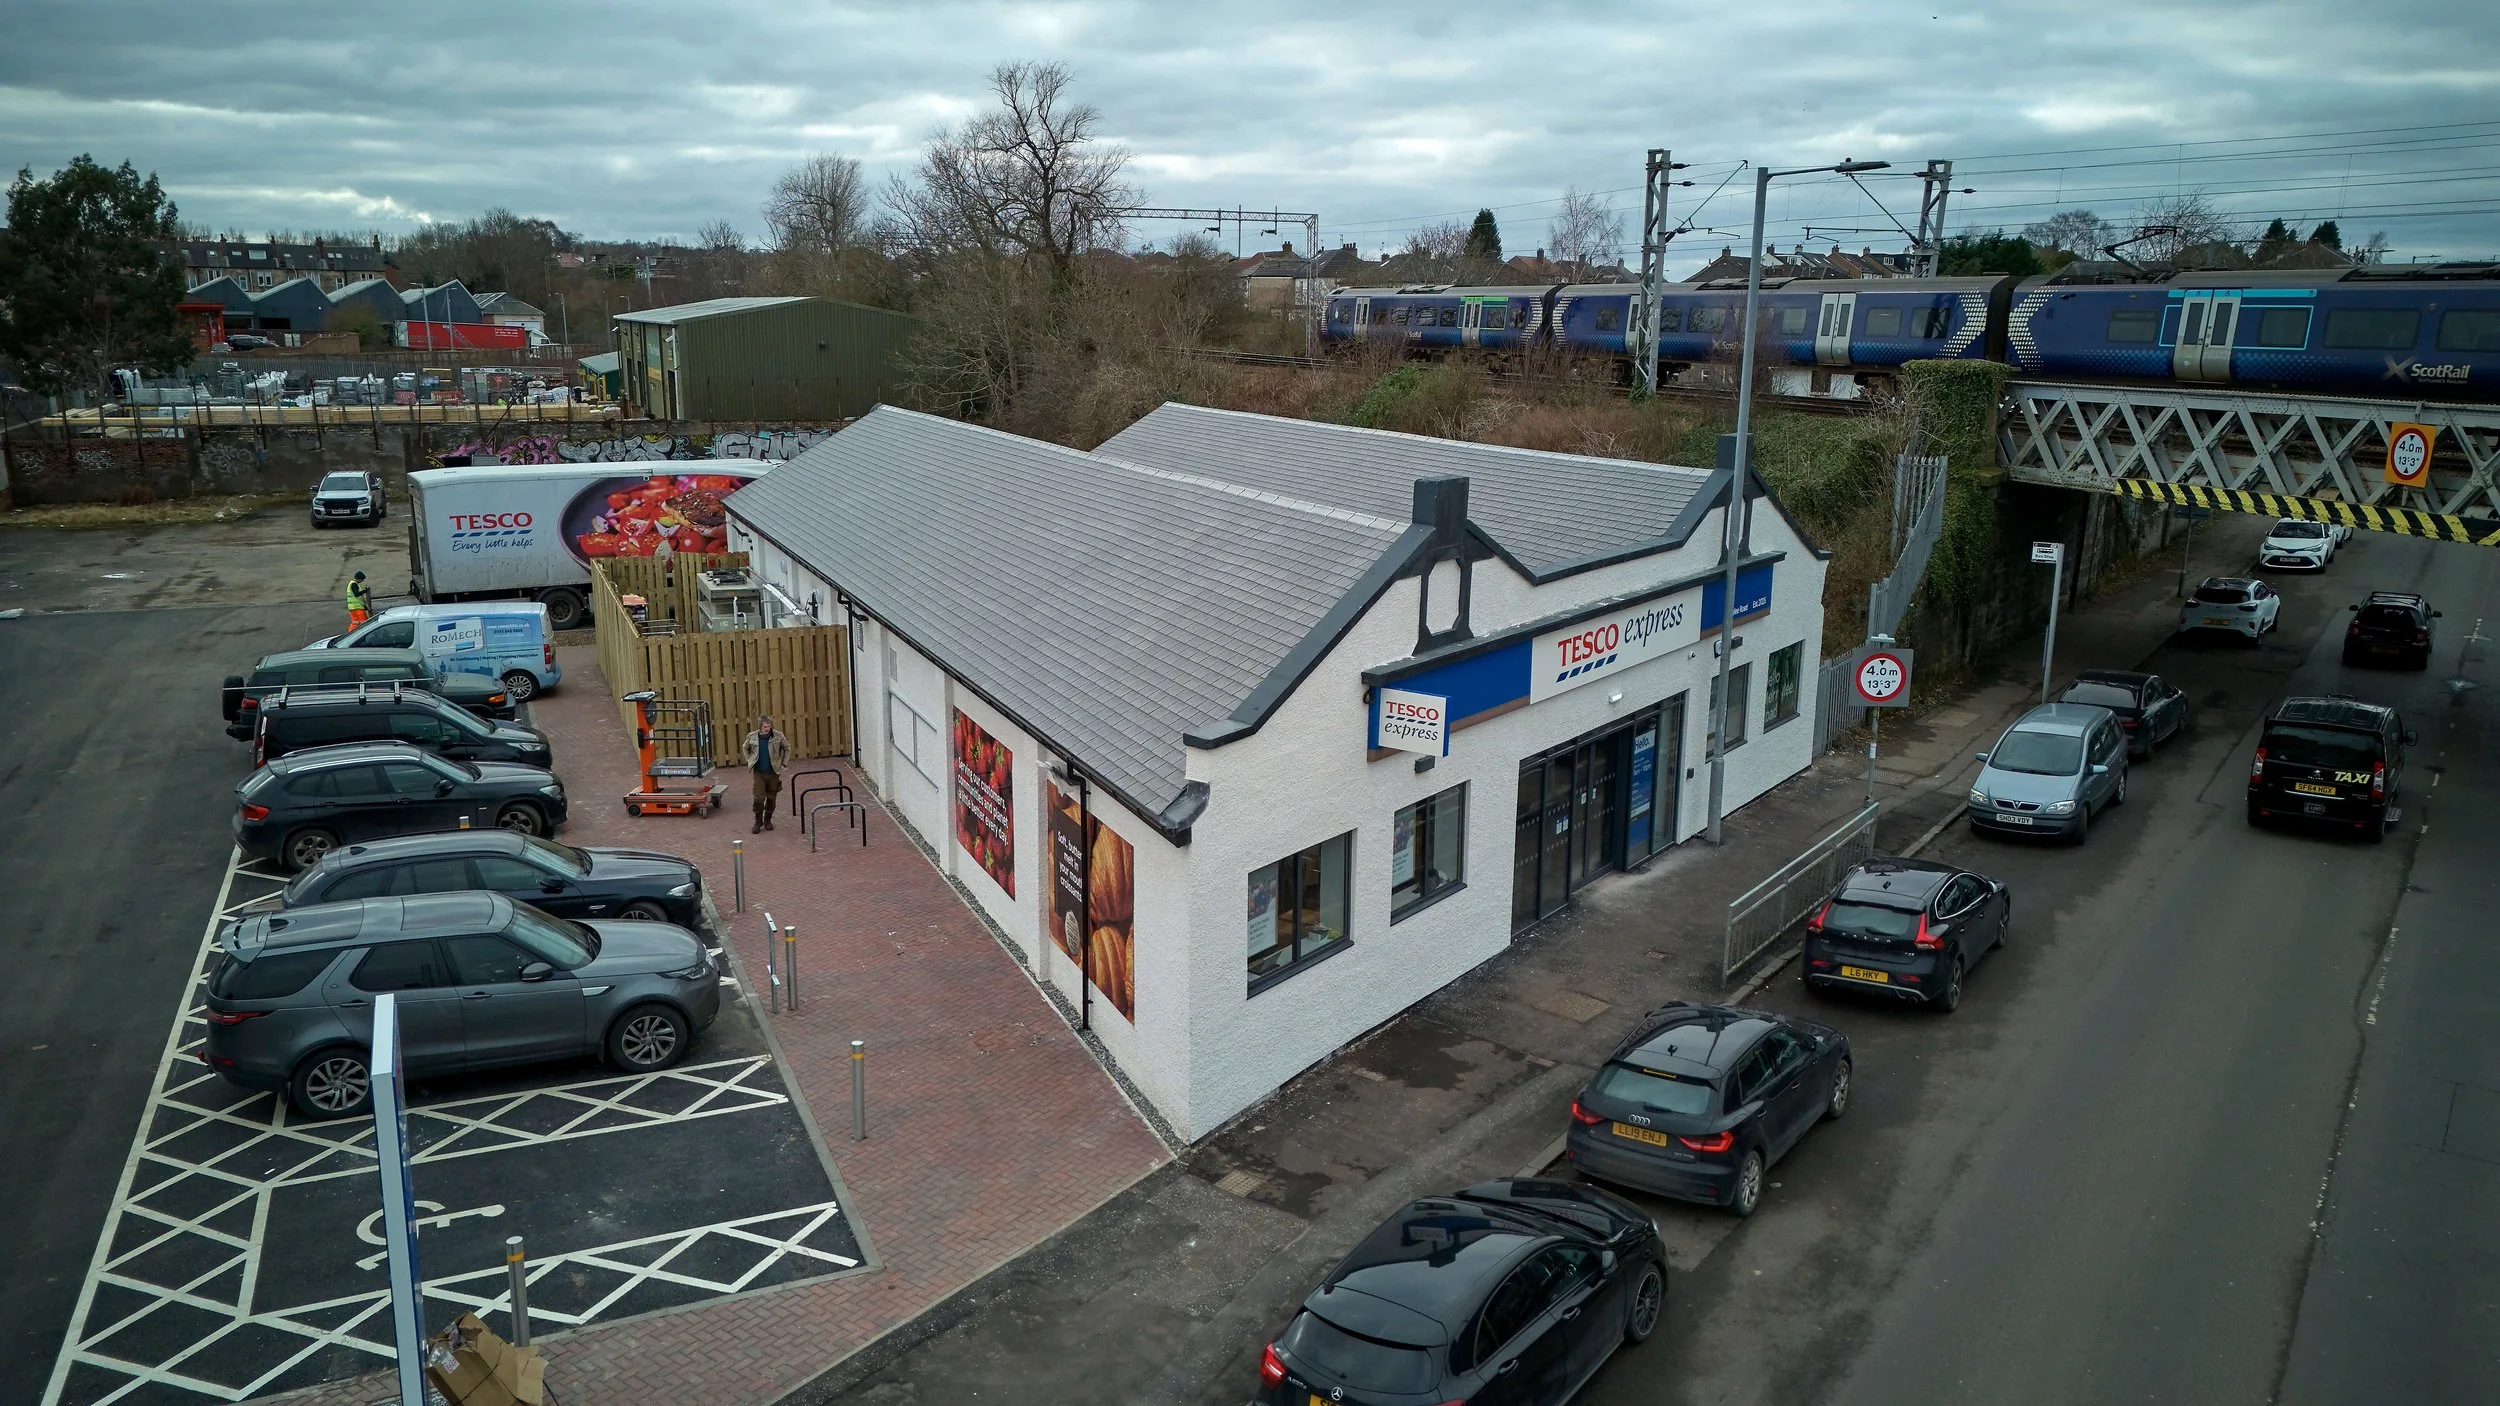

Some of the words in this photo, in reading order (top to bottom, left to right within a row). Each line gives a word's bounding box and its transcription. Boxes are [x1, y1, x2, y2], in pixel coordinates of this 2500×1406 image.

[2410, 363, 2472, 379] ScotRail
[449, 512, 533, 531] TESCO
[451, 540, 482, 554] Every
[485, 539, 508, 549] little
[511, 537, 534, 549] helps
[1557, 623, 1620, 667] TESCO
[1624, 603, 1684, 647] express
[1385, 700, 1440, 721] TESCO
[1384, 722, 1439, 741] express
[957, 756, 973, 784] Serving
[972, 773, 981, 787] our
[2334, 771, 2371, 785] TAXI
[2298, 783, 2317, 791] SF64
[957, 774, 984, 806] communities
[983, 798, 993, 814] and
[993, 806, 1009, 829] planet
[961, 789, 971, 809] little
[971, 800, 985, 822] better
[984, 815, 998, 838] every
[1057, 830, 1068, 850] Soft,
[1058, 861, 1070, 876] your
[1063, 851, 1074, 868] melt
[1849, 967, 1861, 977] L6
[1862, 970, 1880, 980] HKY
[1618, 1126, 1640, 1138] LL19
[1641, 1130, 1662, 1143] ENJ
